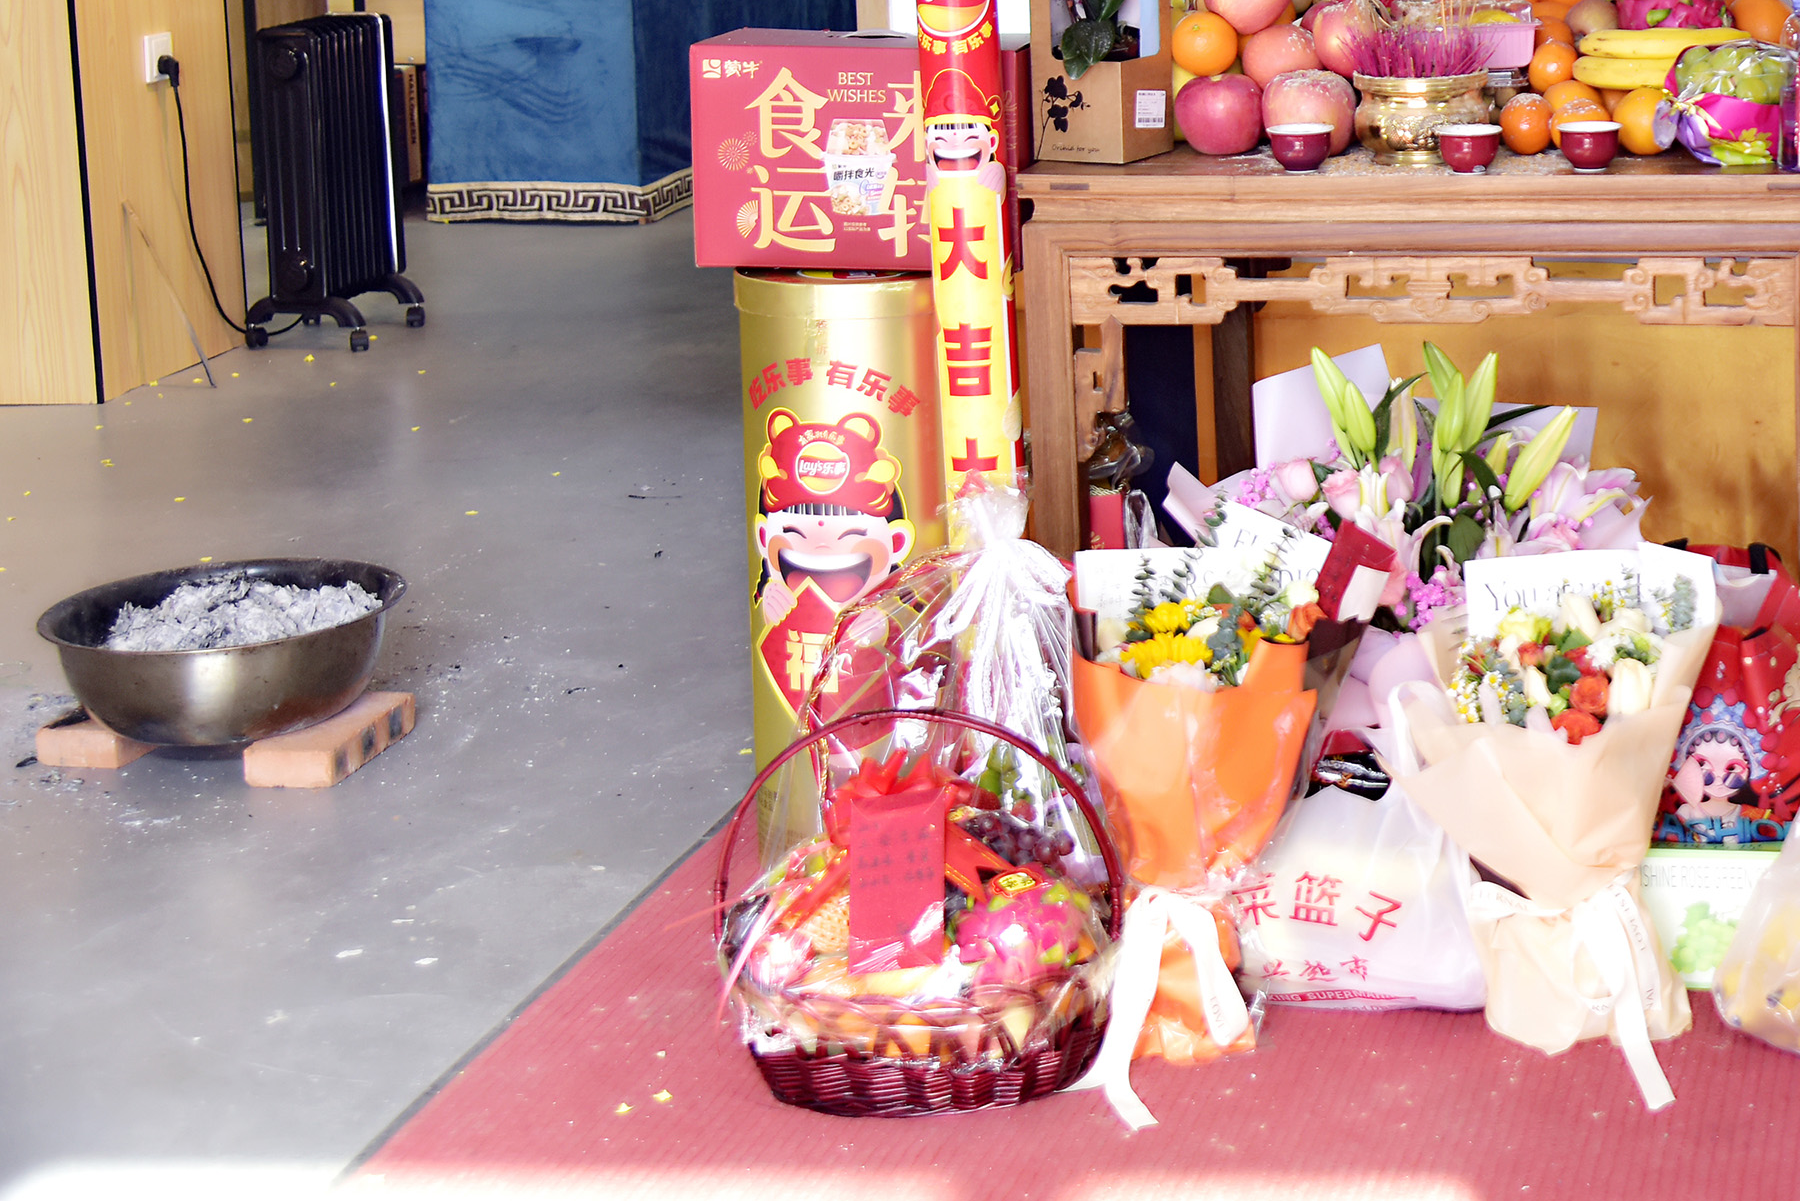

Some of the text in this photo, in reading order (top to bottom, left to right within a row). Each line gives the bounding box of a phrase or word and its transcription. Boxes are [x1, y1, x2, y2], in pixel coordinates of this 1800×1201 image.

[723, 59, 760, 79] 蒙牛
[838, 72, 875, 86] BEST
[827, 88, 887, 104] WISHES
[833, 167, 875, 181] 嚼拌食光
[749, 356, 921, 418] 吃乐事 有乐事
[798, 459, 847, 477] Lay's乐事
[1484, 582, 1537, 611] You
[1653, 813, 1794, 844] ASHIO
[1231, 871, 1403, 942] 菜篮子
